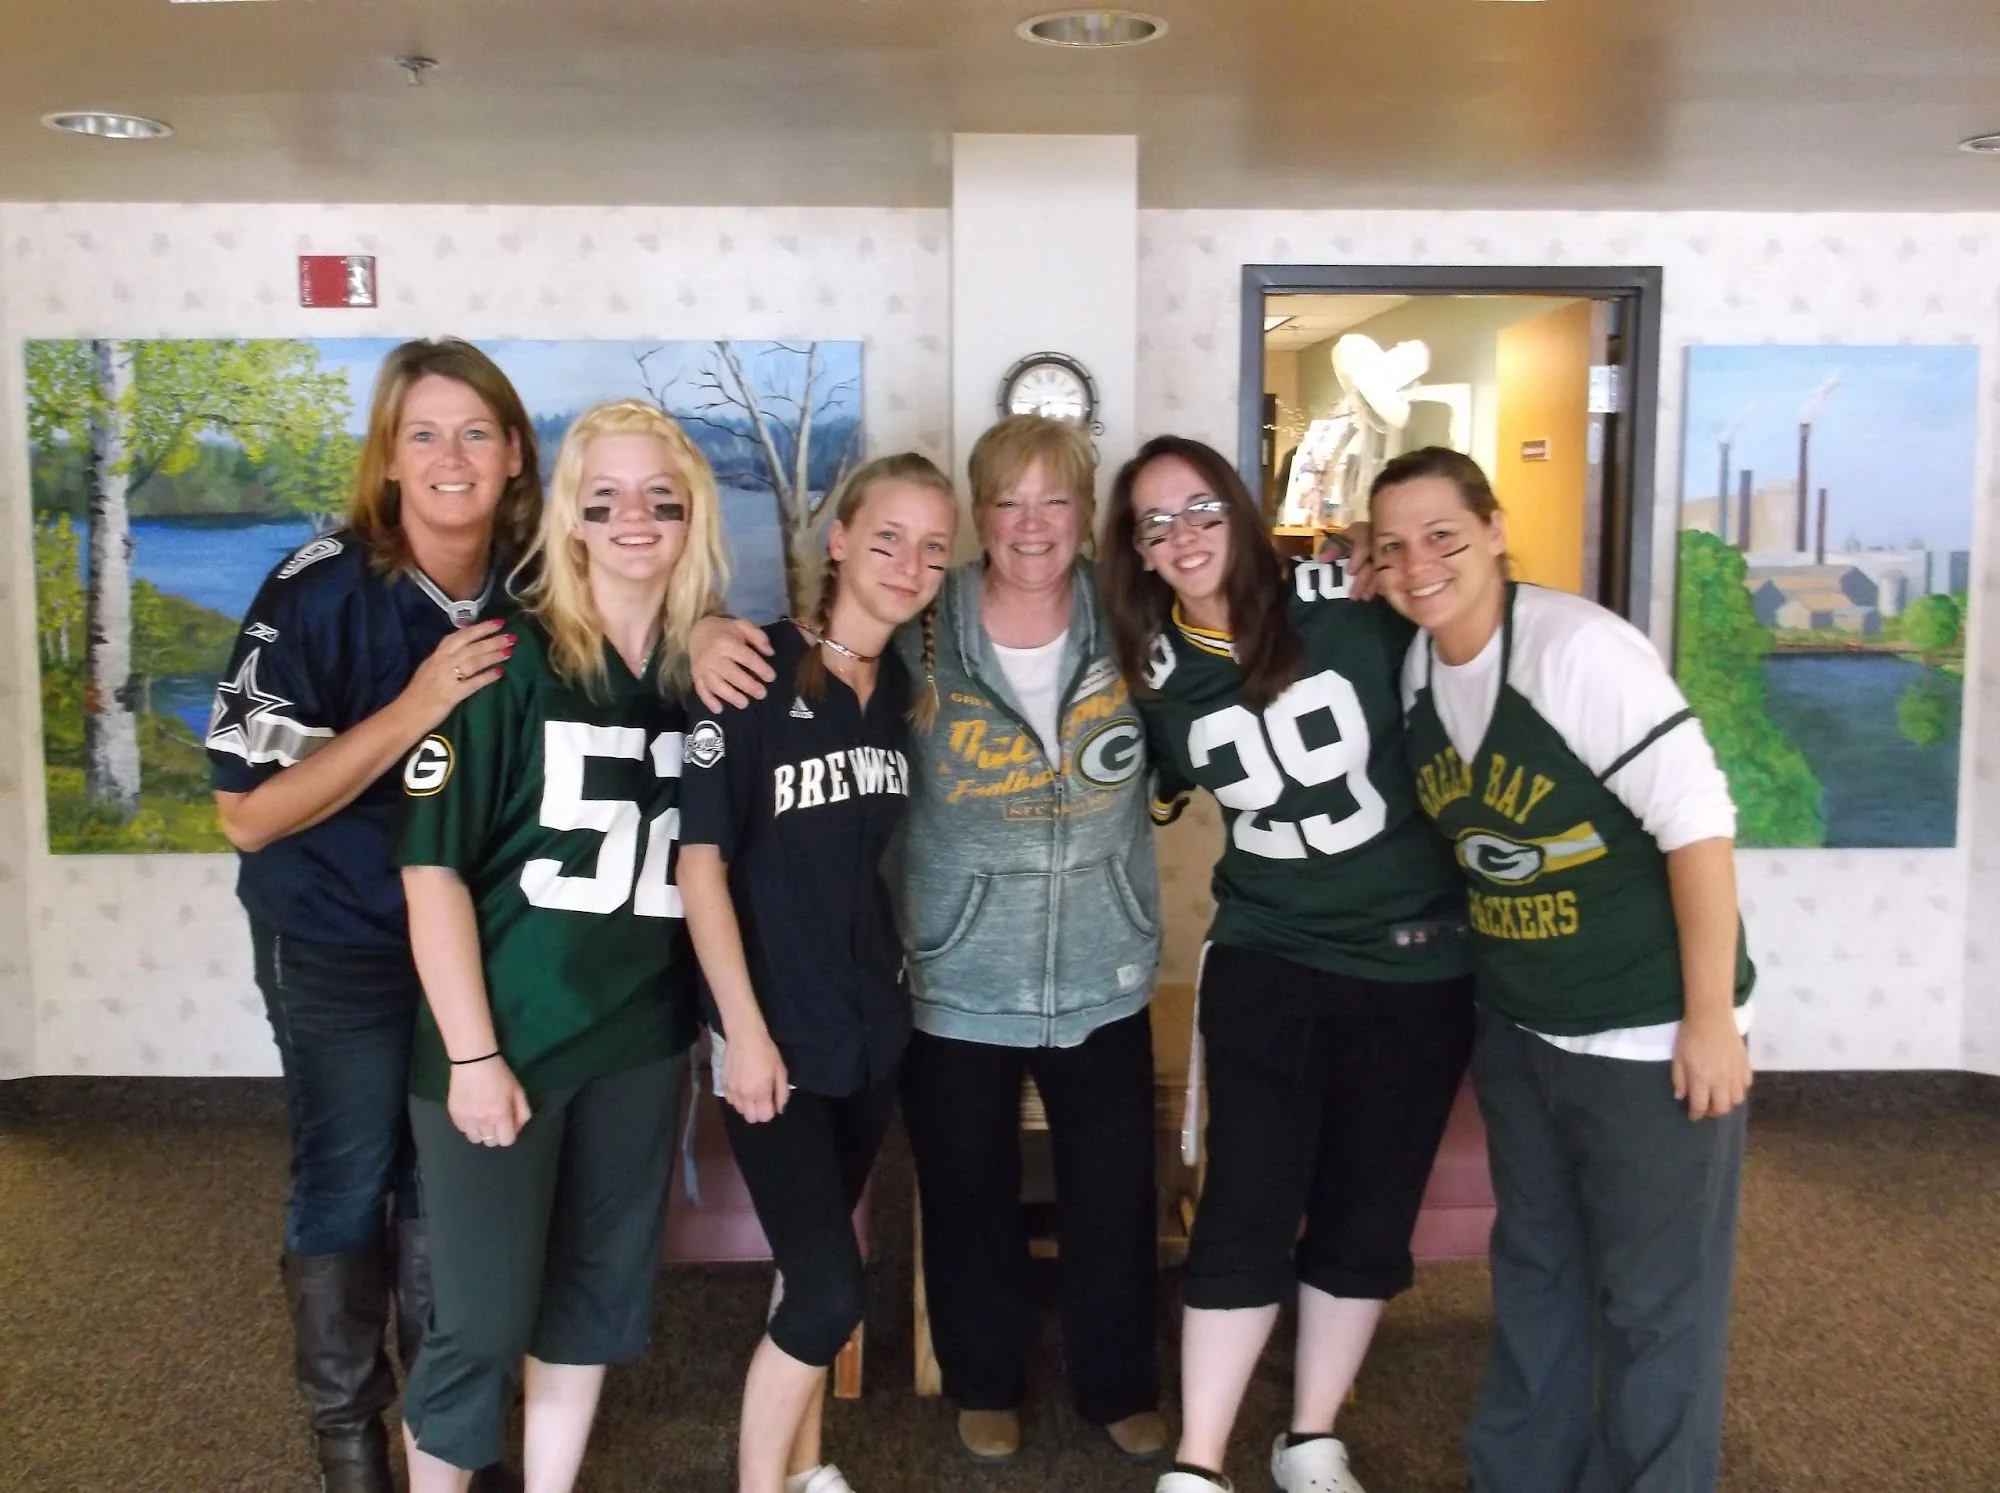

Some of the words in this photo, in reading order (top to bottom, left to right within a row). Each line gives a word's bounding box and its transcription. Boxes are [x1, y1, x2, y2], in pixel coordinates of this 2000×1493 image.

[404, 738, 449, 790] G
[1080, 725, 1143, 782] G
[1187, 669, 1387, 859] 29
[1483, 752, 1556, 825] BAY
